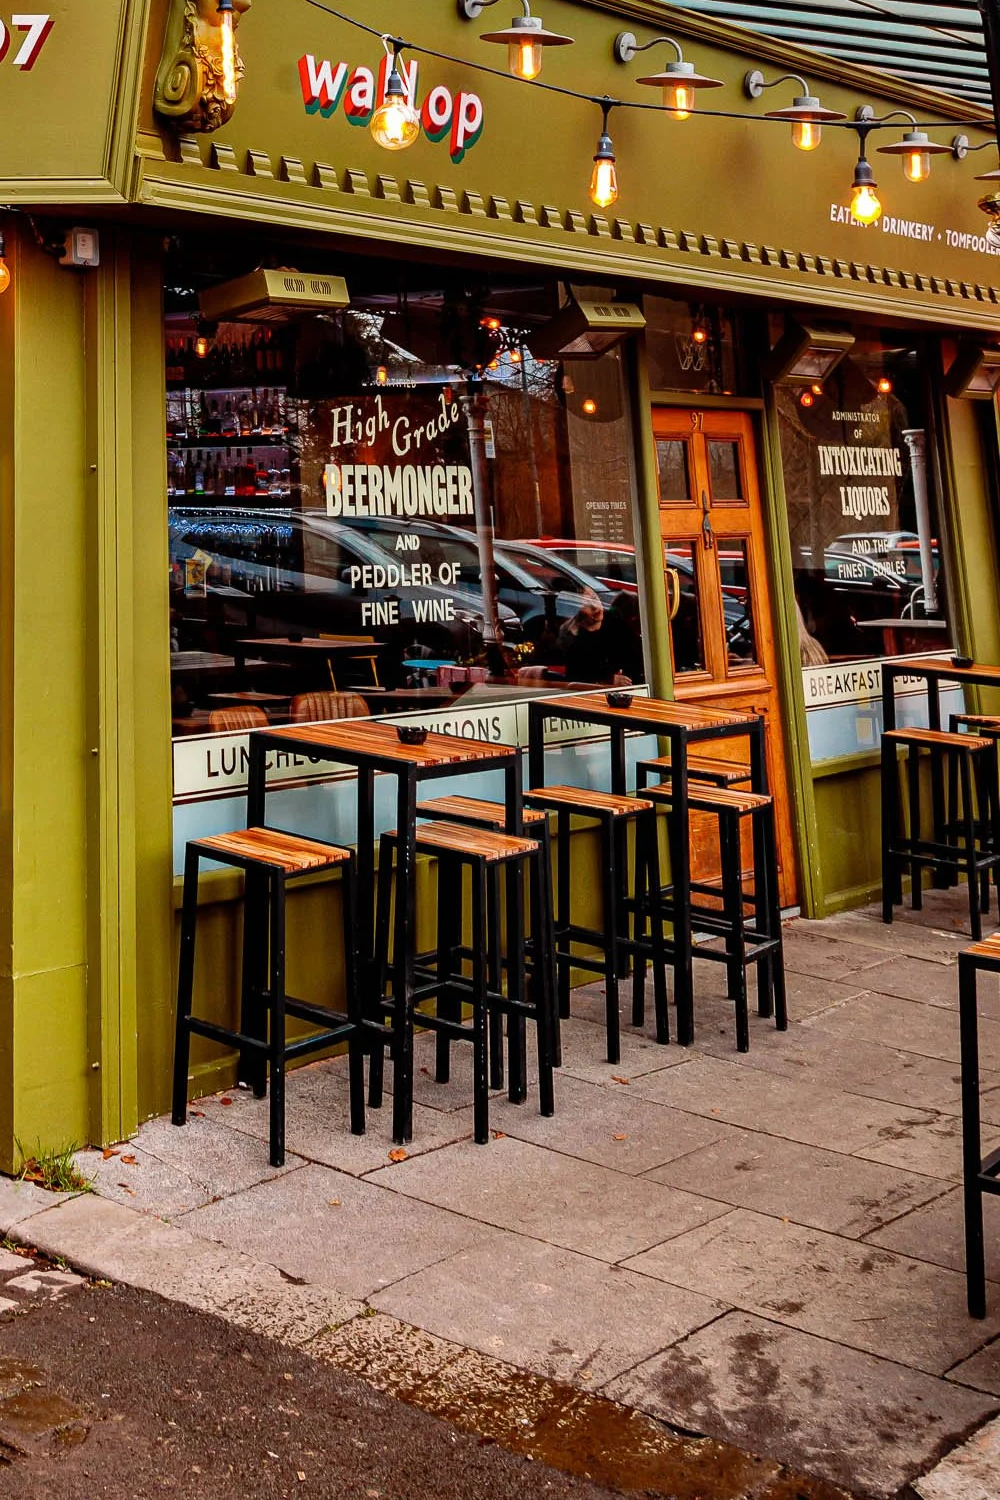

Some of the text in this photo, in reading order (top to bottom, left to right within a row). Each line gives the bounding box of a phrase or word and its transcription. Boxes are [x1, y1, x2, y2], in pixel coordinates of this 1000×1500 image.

[882, 216, 934, 241] DRINKERY
[331, 393, 459, 456] High Grade
[692, 412, 704, 430] 97
[832, 411, 880, 423] ADMINISTRATOR
[854, 429, 863, 439] OF
[818, 446, 902, 476] INTOXICATING
[325, 464, 474, 517] BEERMONGER
[585, 501, 627, 510] OPENING TIMES
[840, 487, 890, 520] LIQUORS
[395, 535, 420, 550] AND
[852, 539, 888, 554] AND THE
[350, 562, 461, 589] PEDDLER OF
[838, 560, 906, 579] FINEST EDIBLES
[361, 598, 455, 627] FINE WINE
[810, 669, 880, 697] BREAKFAST
